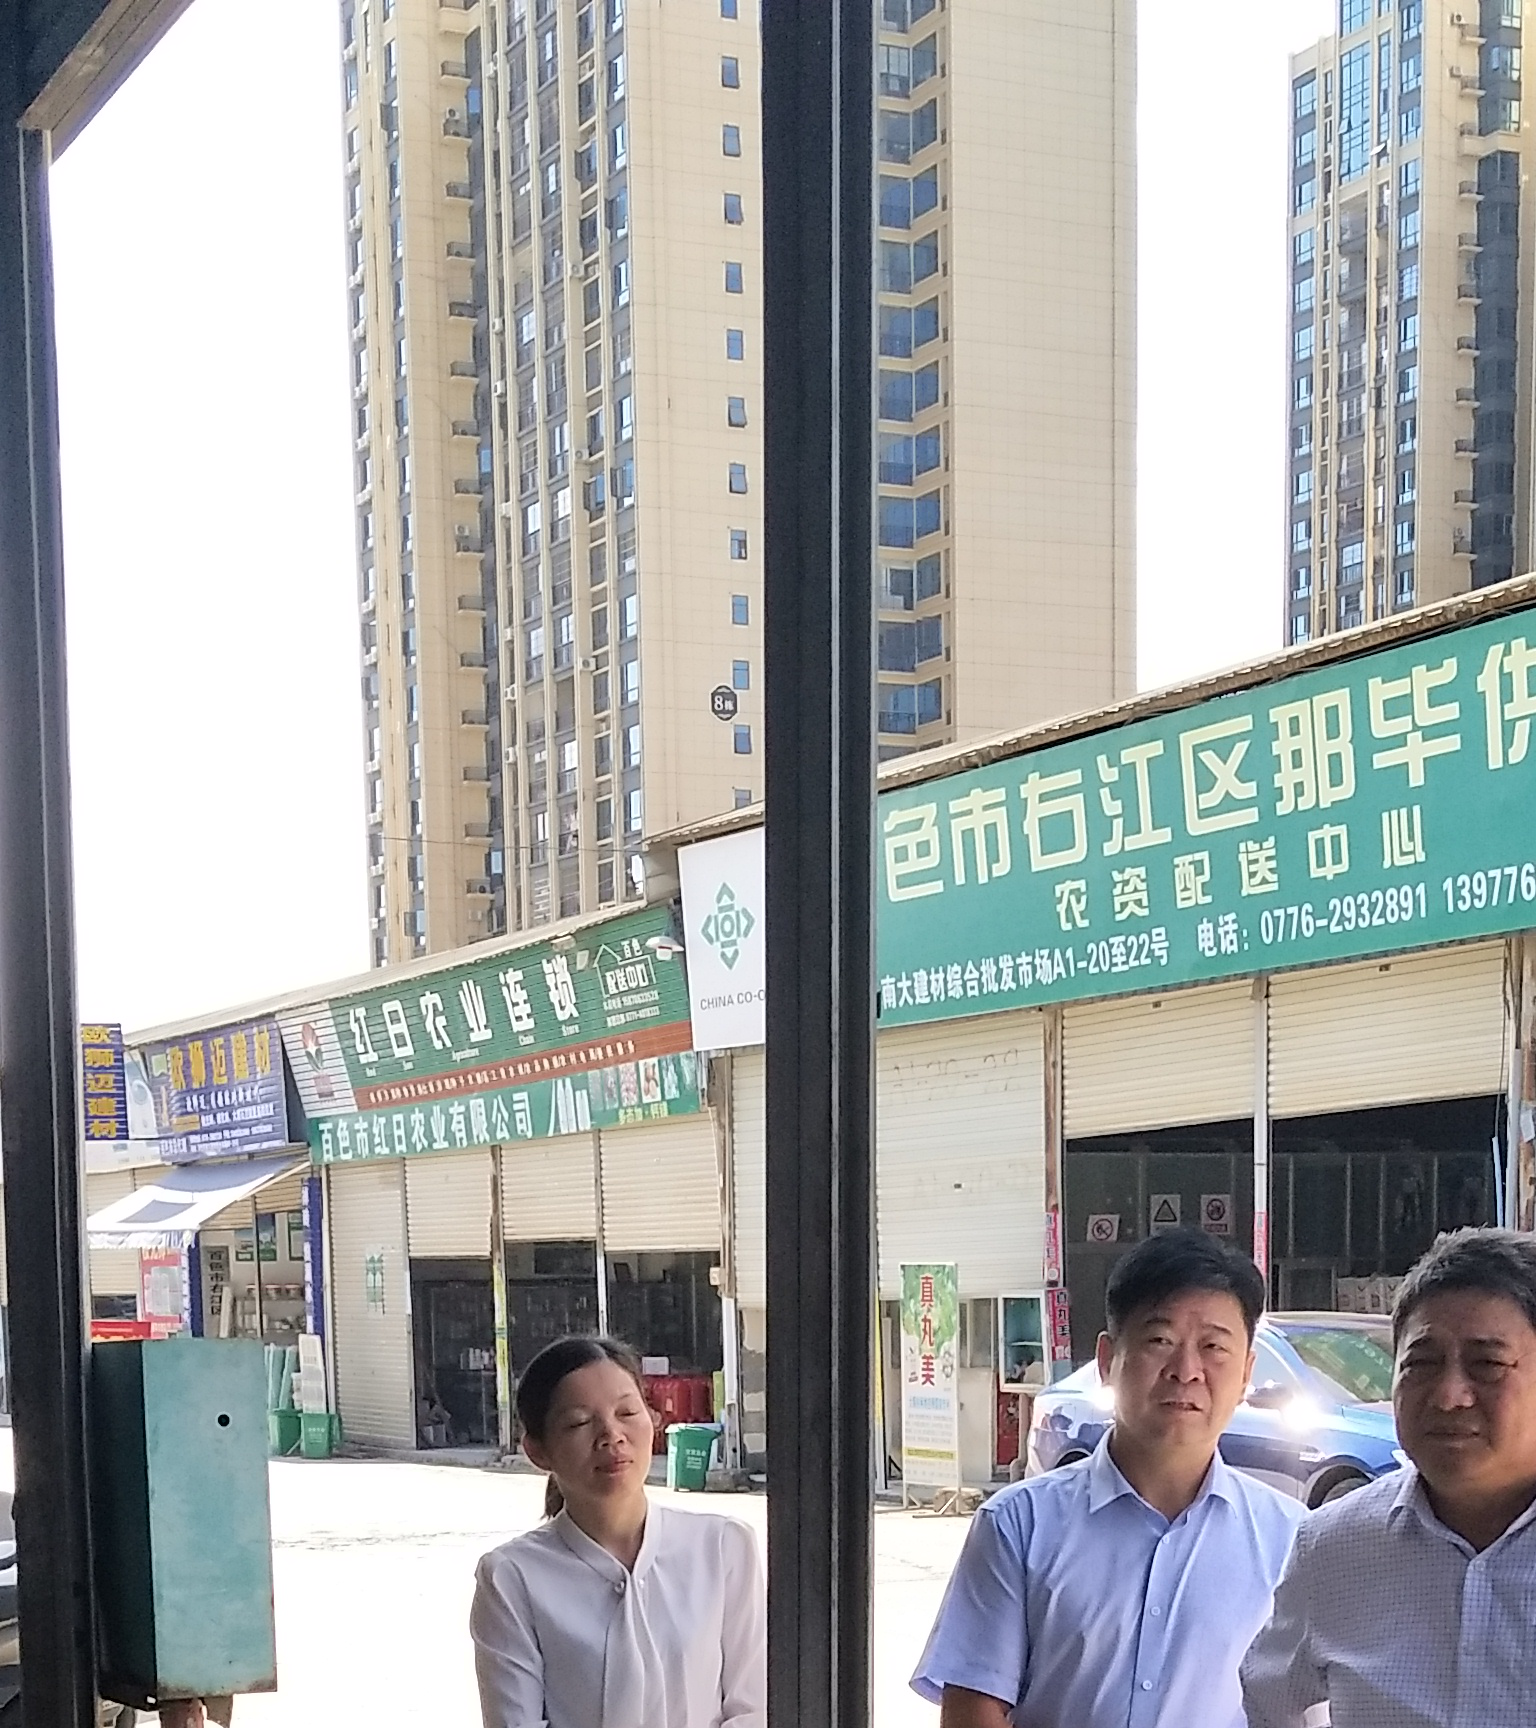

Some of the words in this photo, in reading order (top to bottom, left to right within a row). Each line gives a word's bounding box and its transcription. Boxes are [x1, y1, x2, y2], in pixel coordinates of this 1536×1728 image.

[1054, 803, 1426, 931] 农资配送中心
[1260, 882, 1428, 946] 0776-2932891
[349, 954, 581, 1064] 红日农业连锁
[699, 994, 735, 1011] CHINA
[318, 1091, 534, 1162] 百色市红日农业有限公司
[919, 1274, 936, 1387] 真丸美
